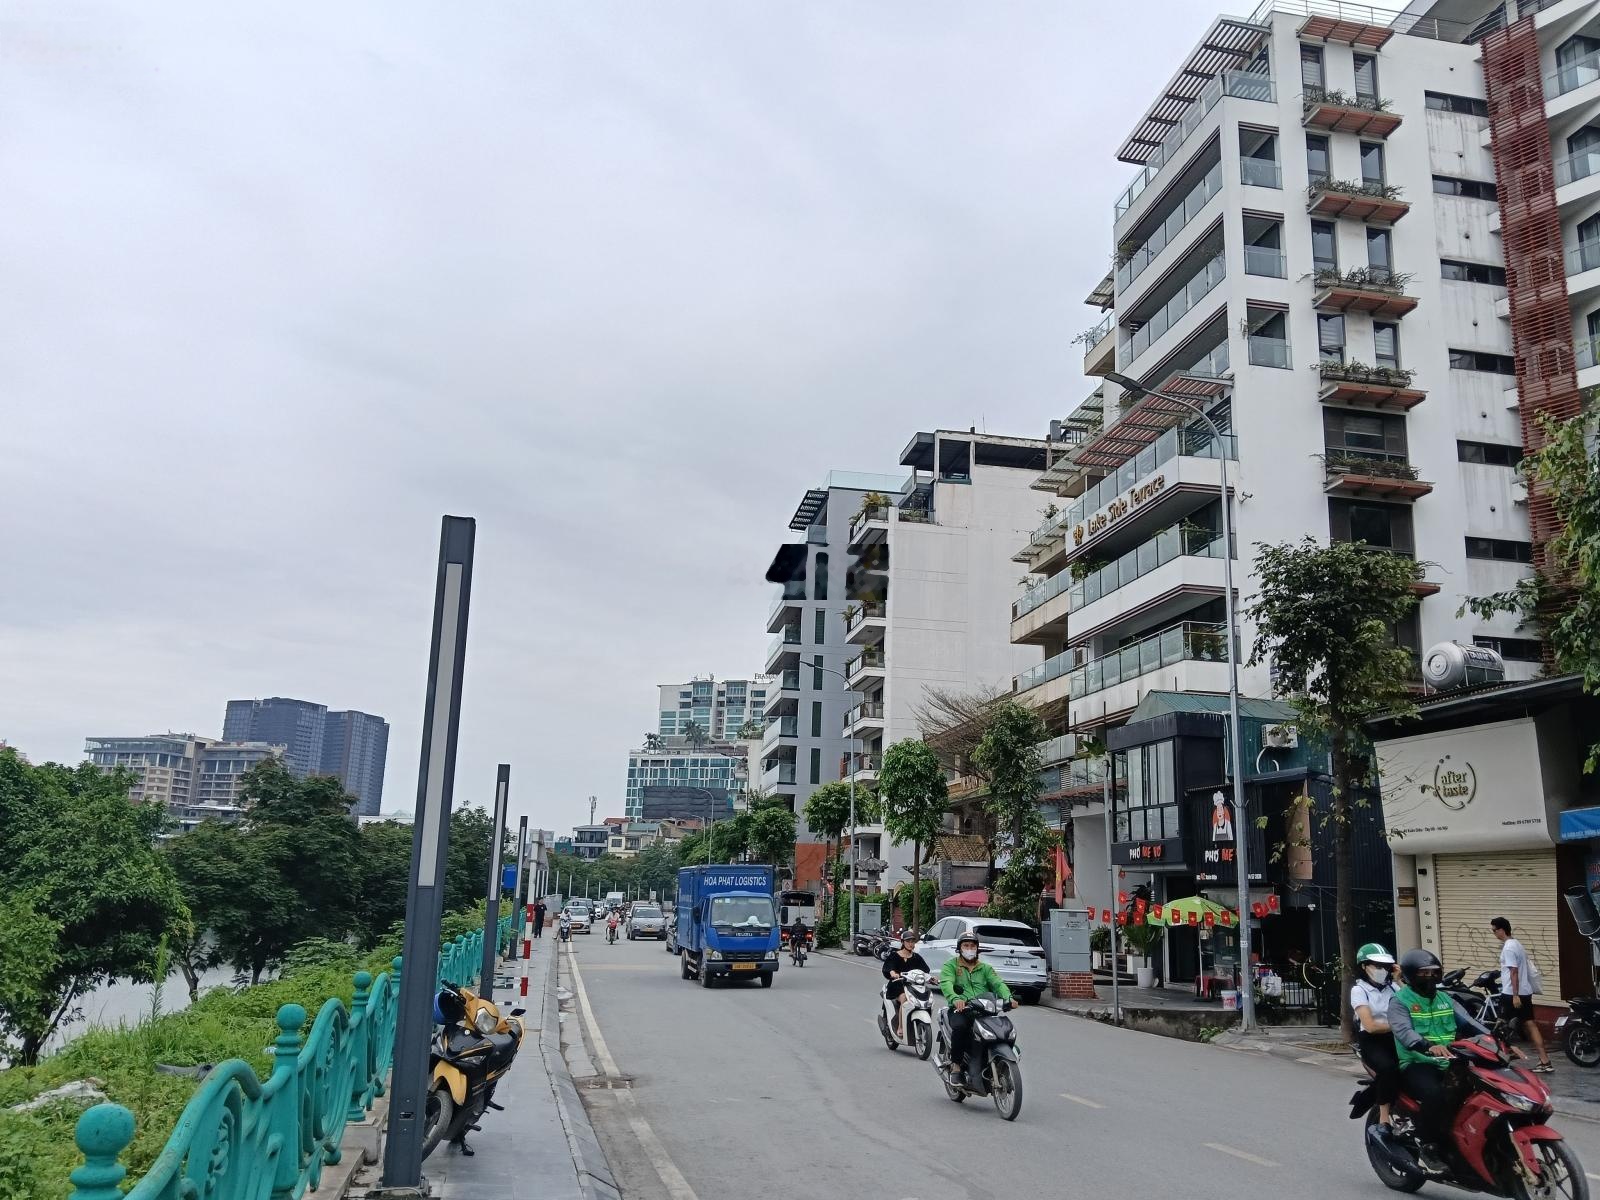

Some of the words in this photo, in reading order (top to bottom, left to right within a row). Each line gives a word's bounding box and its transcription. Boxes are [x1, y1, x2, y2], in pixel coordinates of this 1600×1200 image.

[1087, 513, 1107, 537] Lake
[1107, 498, 1128, 523] Side
[1128, 474, 1165, 508] Terrace
[1440, 770, 1468, 785] after
[1442, 784, 1469, 798] taste
[1204, 843, 1220, 863] PHỞ
[703, 876, 718, 886] HOA
[718, 876, 735, 886] PHAT
[734, 876, 767, 886] LOGISTICS
